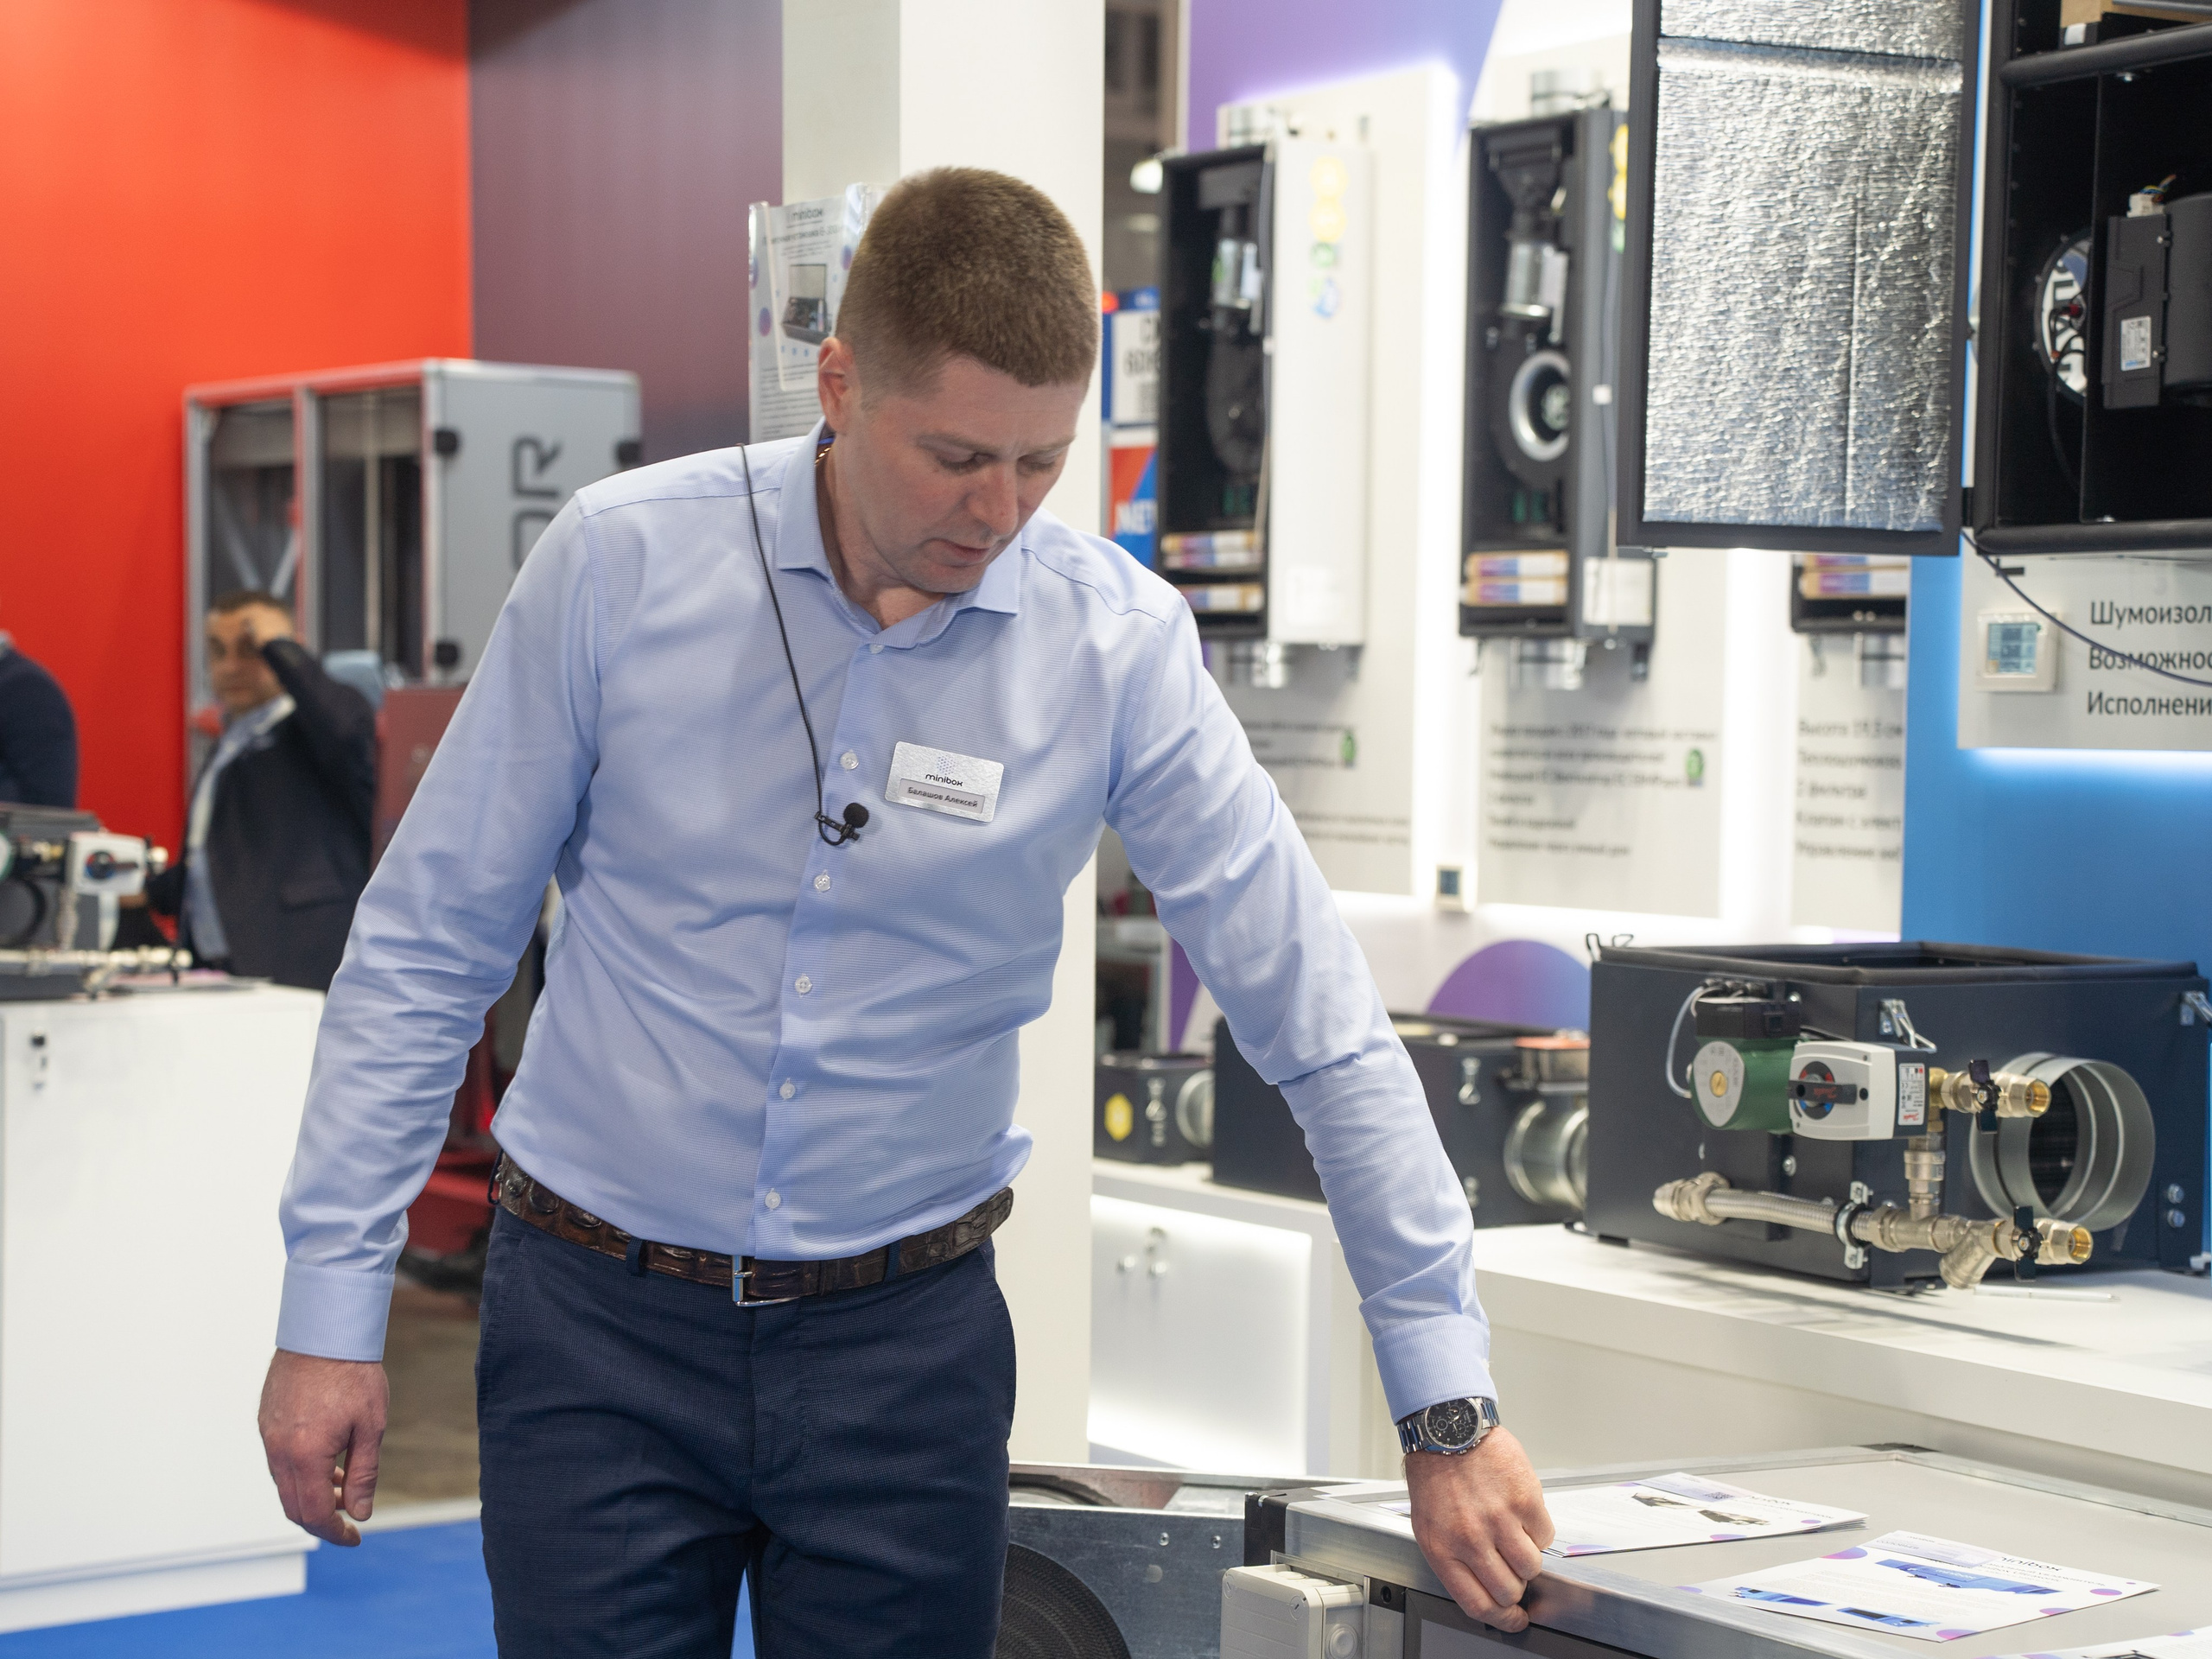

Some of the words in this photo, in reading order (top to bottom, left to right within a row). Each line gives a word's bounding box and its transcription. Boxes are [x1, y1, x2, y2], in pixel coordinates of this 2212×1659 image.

[2090, 601, 2212, 630] Шумоизол
[2087, 691, 2212, 715] Исполнени
[925, 773, 963, 786] minibox
[908, 787, 944, 799] Балашов
[945, 795, 978, 807] Алексей
